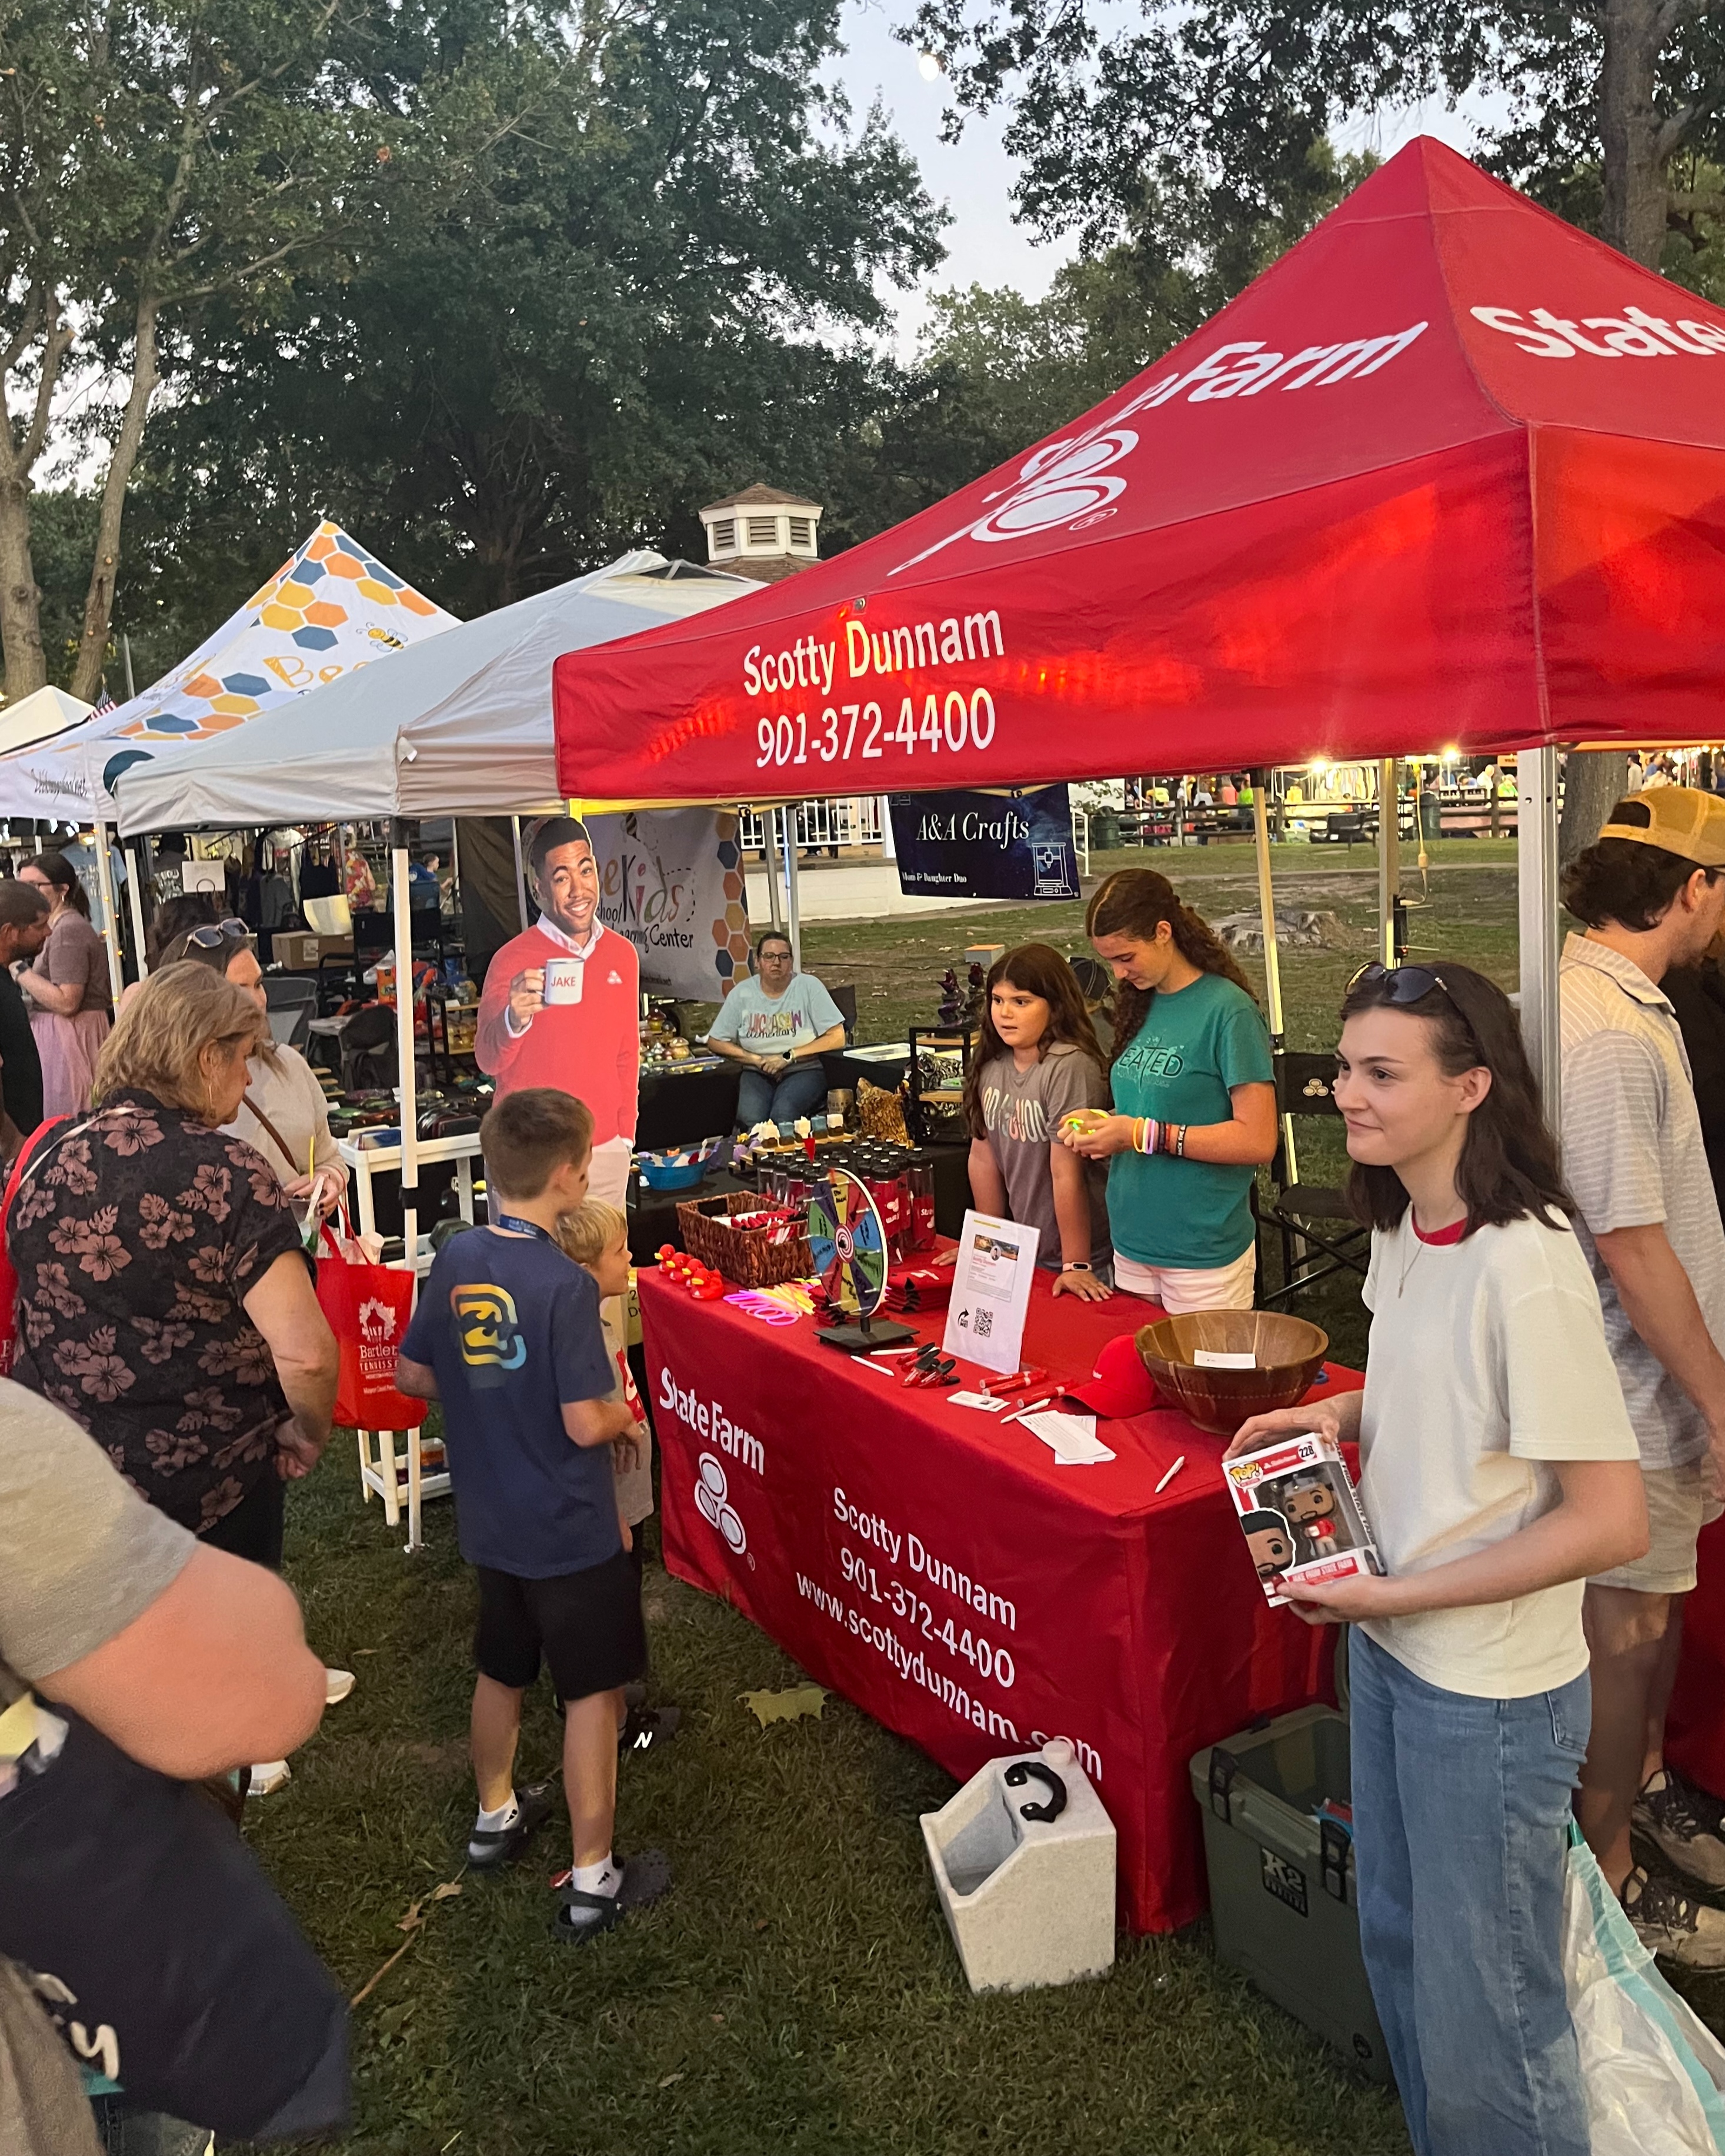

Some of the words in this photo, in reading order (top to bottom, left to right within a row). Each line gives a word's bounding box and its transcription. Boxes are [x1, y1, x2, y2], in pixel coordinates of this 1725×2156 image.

[1469, 305, 1725, 358] State
[743, 634, 836, 696] Scotty
[845, 610, 1005, 678] Dunnam
[756, 687, 996, 768] 901-372-4400
[916, 813, 957, 841] A&A
[962, 810, 1029, 849] Crafts
[923, 873, 952, 885] Daughter
[954, 873, 967, 883] Duo
[650, 923, 693, 948] Center
[551, 976, 576, 987] JAKE
[359, 1344, 398, 1359] Bartlet
[359, 1360, 399, 1371] TENNESS
[1299, 1445, 1314, 1458] 228
[1229, 1462, 1260, 1484] POP!
[833, 1487, 901, 1564] Scotty
[908, 1533, 1016, 1631] Dunnam
[840, 1547, 1015, 1688] 901-372-4400
